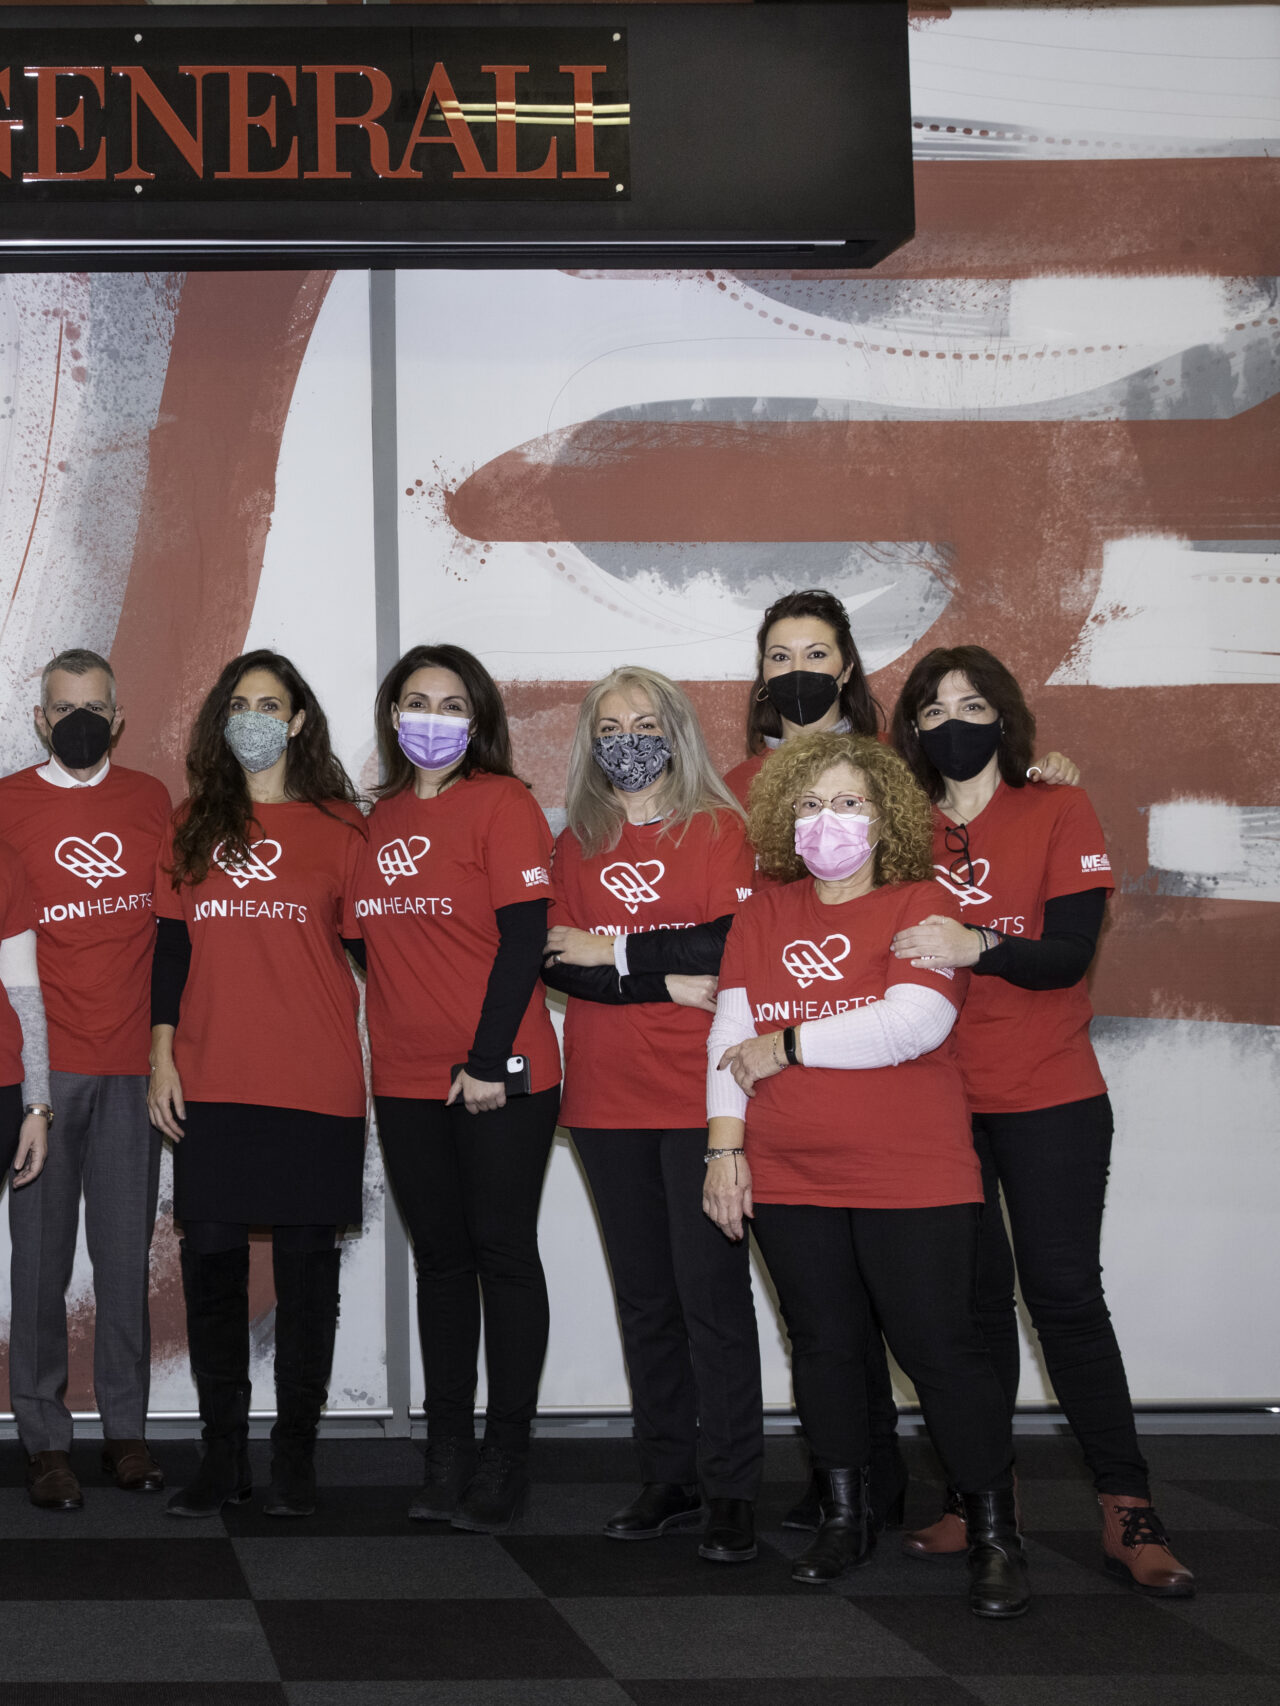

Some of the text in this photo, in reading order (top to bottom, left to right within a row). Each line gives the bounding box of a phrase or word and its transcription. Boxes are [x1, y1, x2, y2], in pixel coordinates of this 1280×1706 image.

[39, 892, 153, 923] IONHEARTS
[193, 899, 307, 923] IONHEARTS
[355, 896, 453, 919] IONHEARTS
